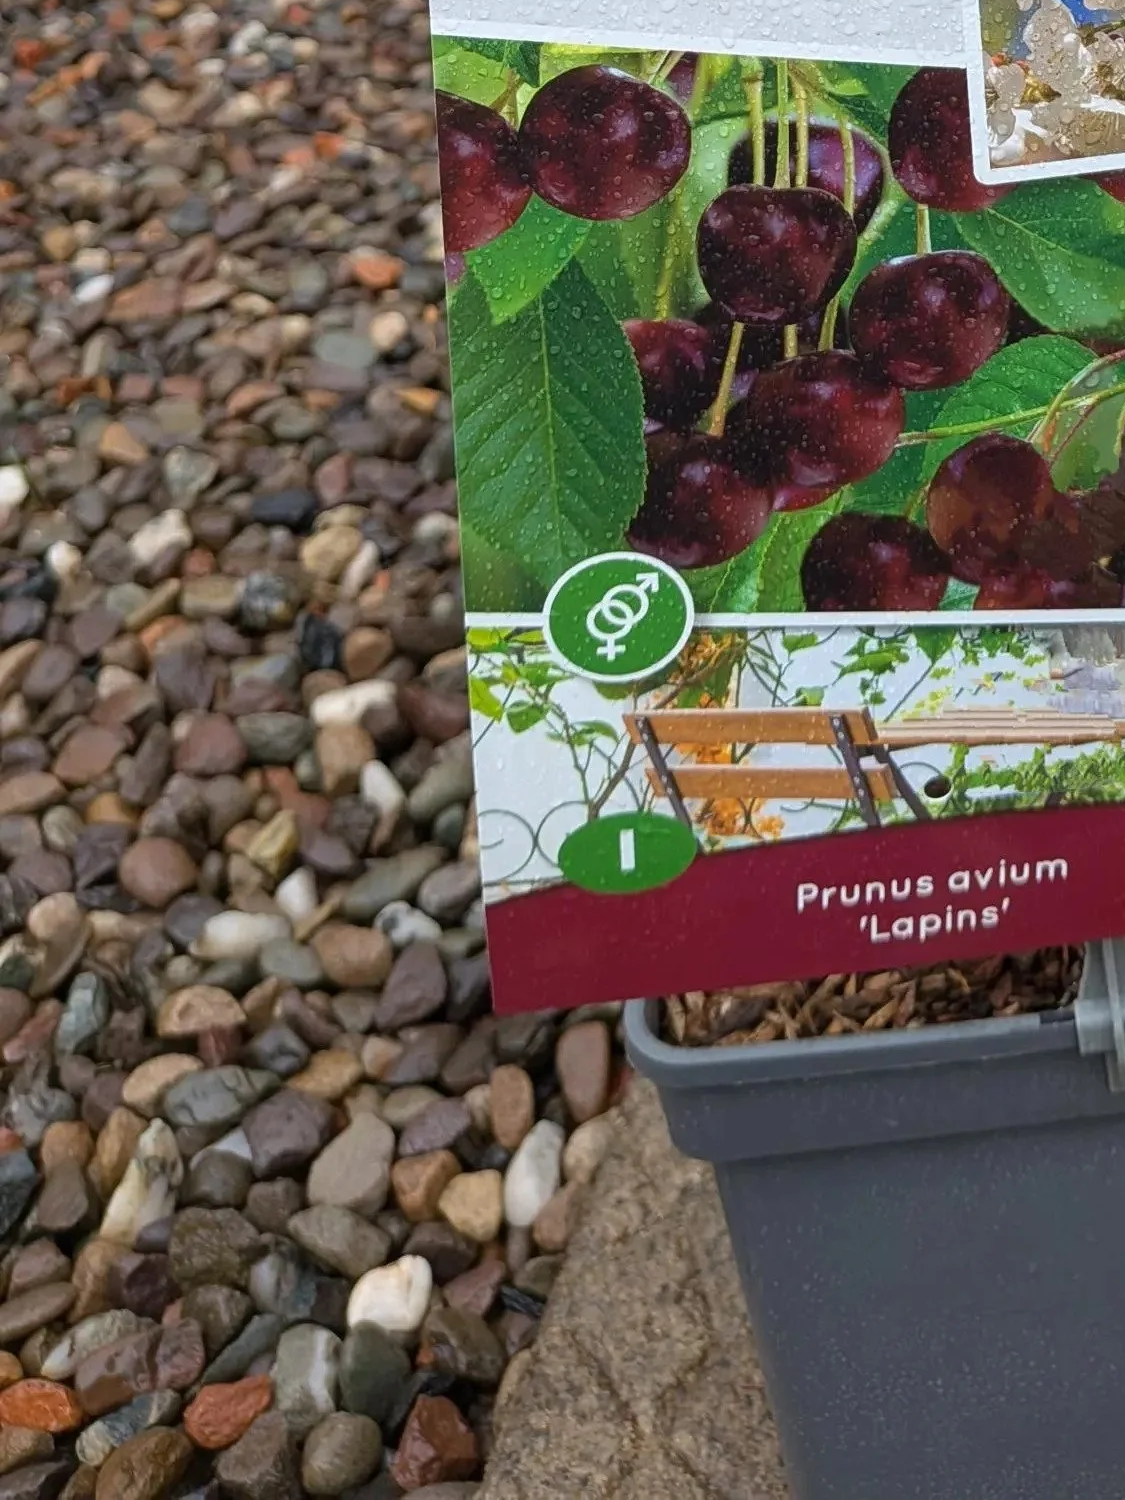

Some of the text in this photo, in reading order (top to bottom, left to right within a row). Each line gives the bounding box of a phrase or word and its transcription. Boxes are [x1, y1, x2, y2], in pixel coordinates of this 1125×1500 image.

[797, 858, 1068, 913] Prunus avium
[859, 897, 1010, 943] 'Lapins'
